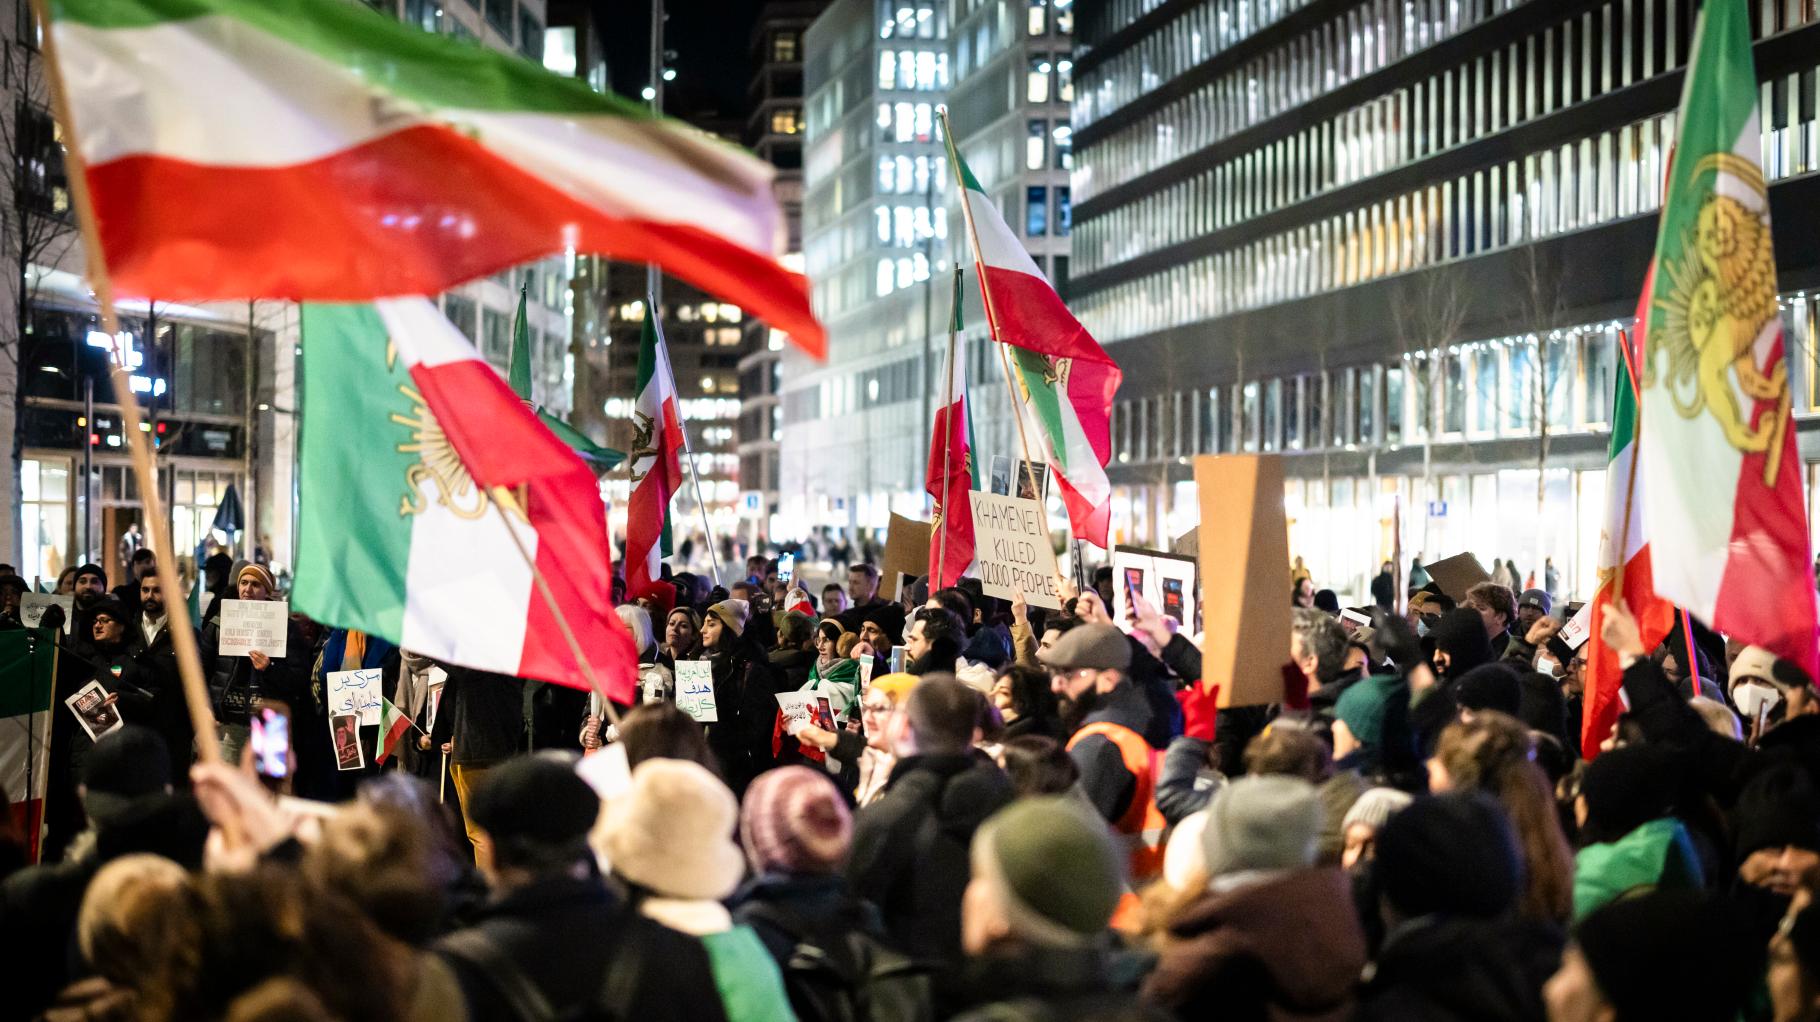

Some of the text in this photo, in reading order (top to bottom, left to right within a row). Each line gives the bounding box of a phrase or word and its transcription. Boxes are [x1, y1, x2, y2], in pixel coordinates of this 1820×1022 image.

[974, 497, 1043, 537] KHAMENEI
[993, 537, 1036, 565] KILLED
[1012, 567, 1056, 597] PEOPLE
[683, 680, 712, 695] هدف
